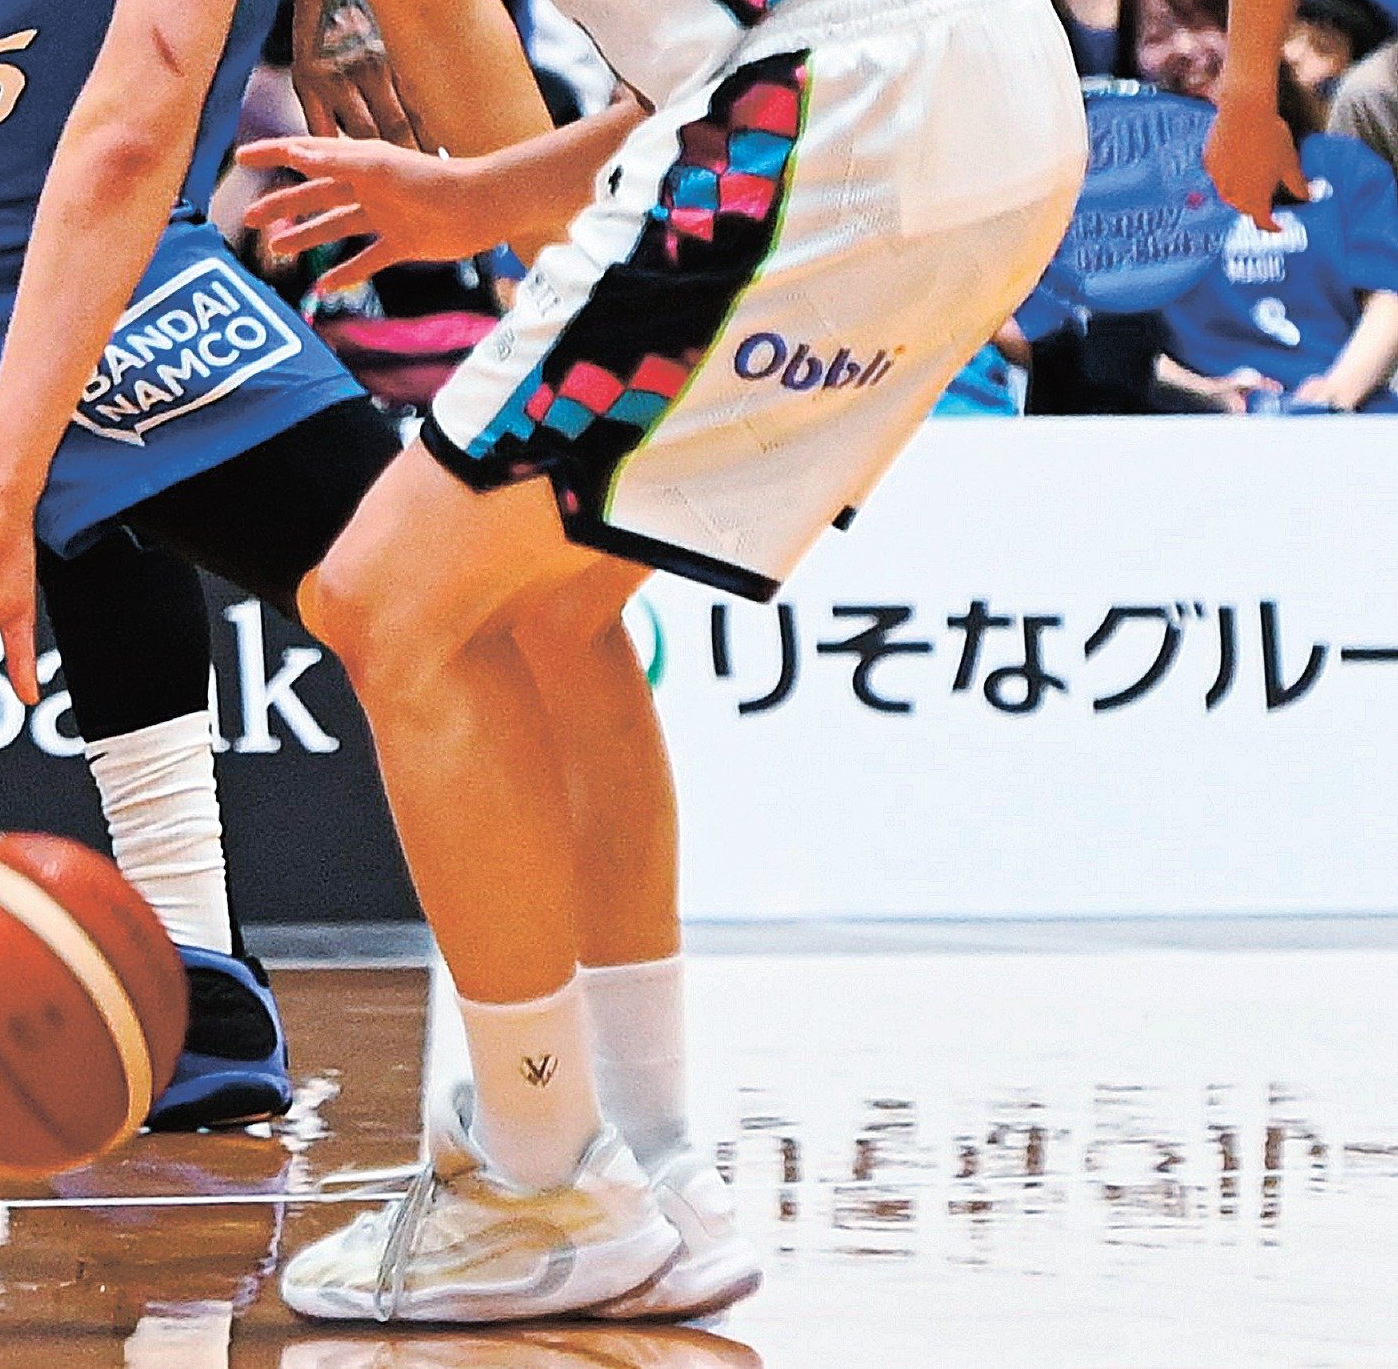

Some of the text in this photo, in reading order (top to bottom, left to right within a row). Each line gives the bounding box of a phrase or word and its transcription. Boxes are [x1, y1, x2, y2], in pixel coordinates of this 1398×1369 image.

[83, 281, 241, 402] BANDAI
[96, 316, 267, 422] NAMCO
[734, 332, 906, 390] Obbli
